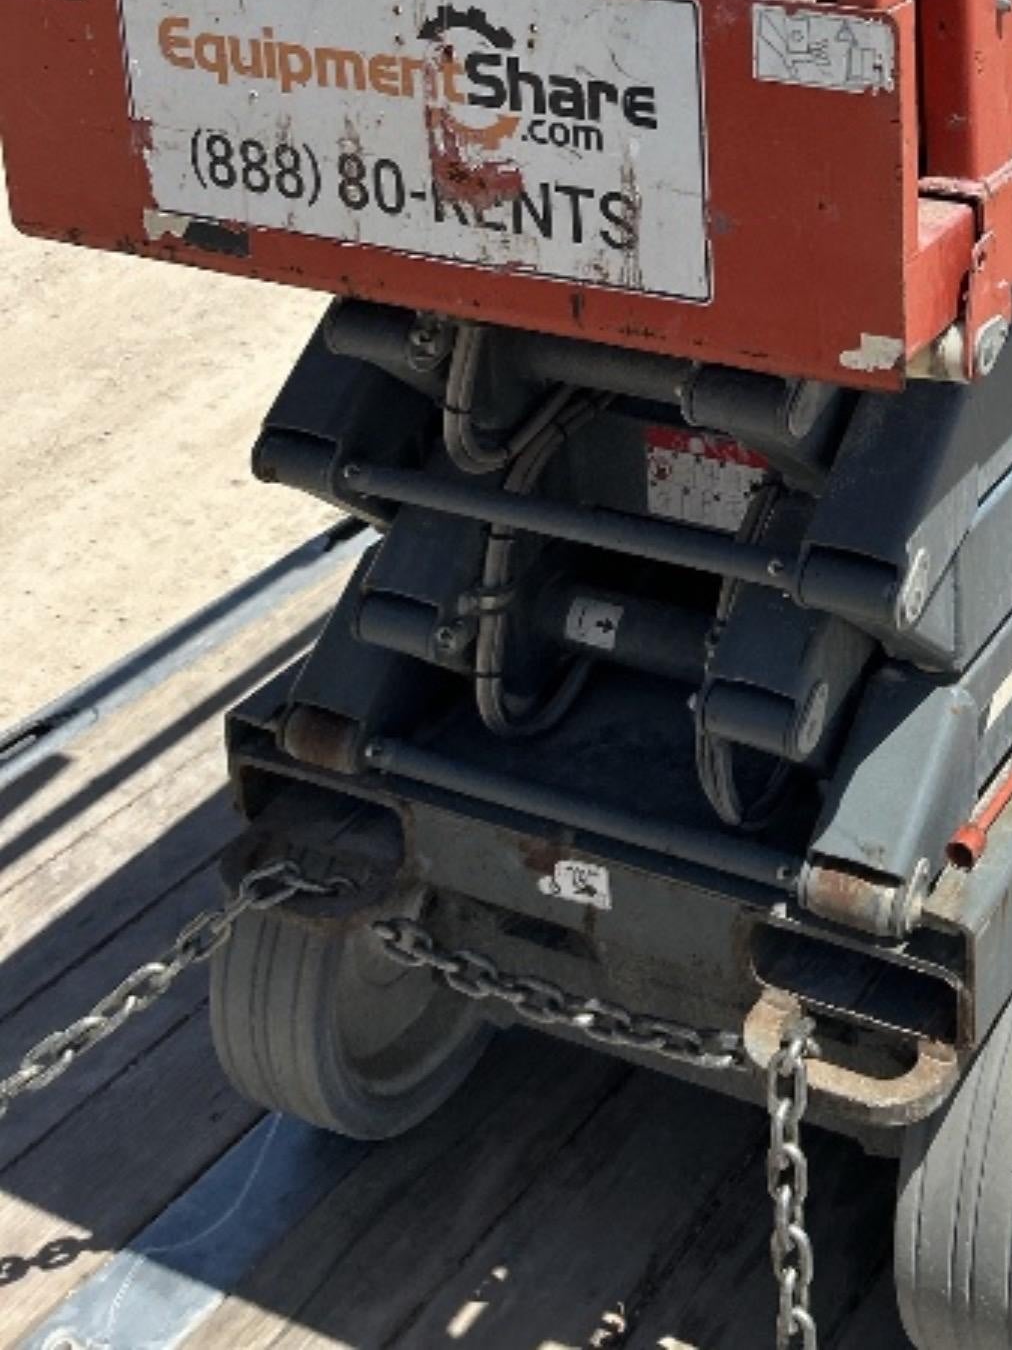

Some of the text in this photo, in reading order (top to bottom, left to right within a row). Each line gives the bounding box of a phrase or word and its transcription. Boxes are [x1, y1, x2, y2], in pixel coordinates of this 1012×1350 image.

[157, 16, 658, 130] EquipmentShare
[191, 127, 322, 208] (888)
[520, 118, 604, 152] .com
